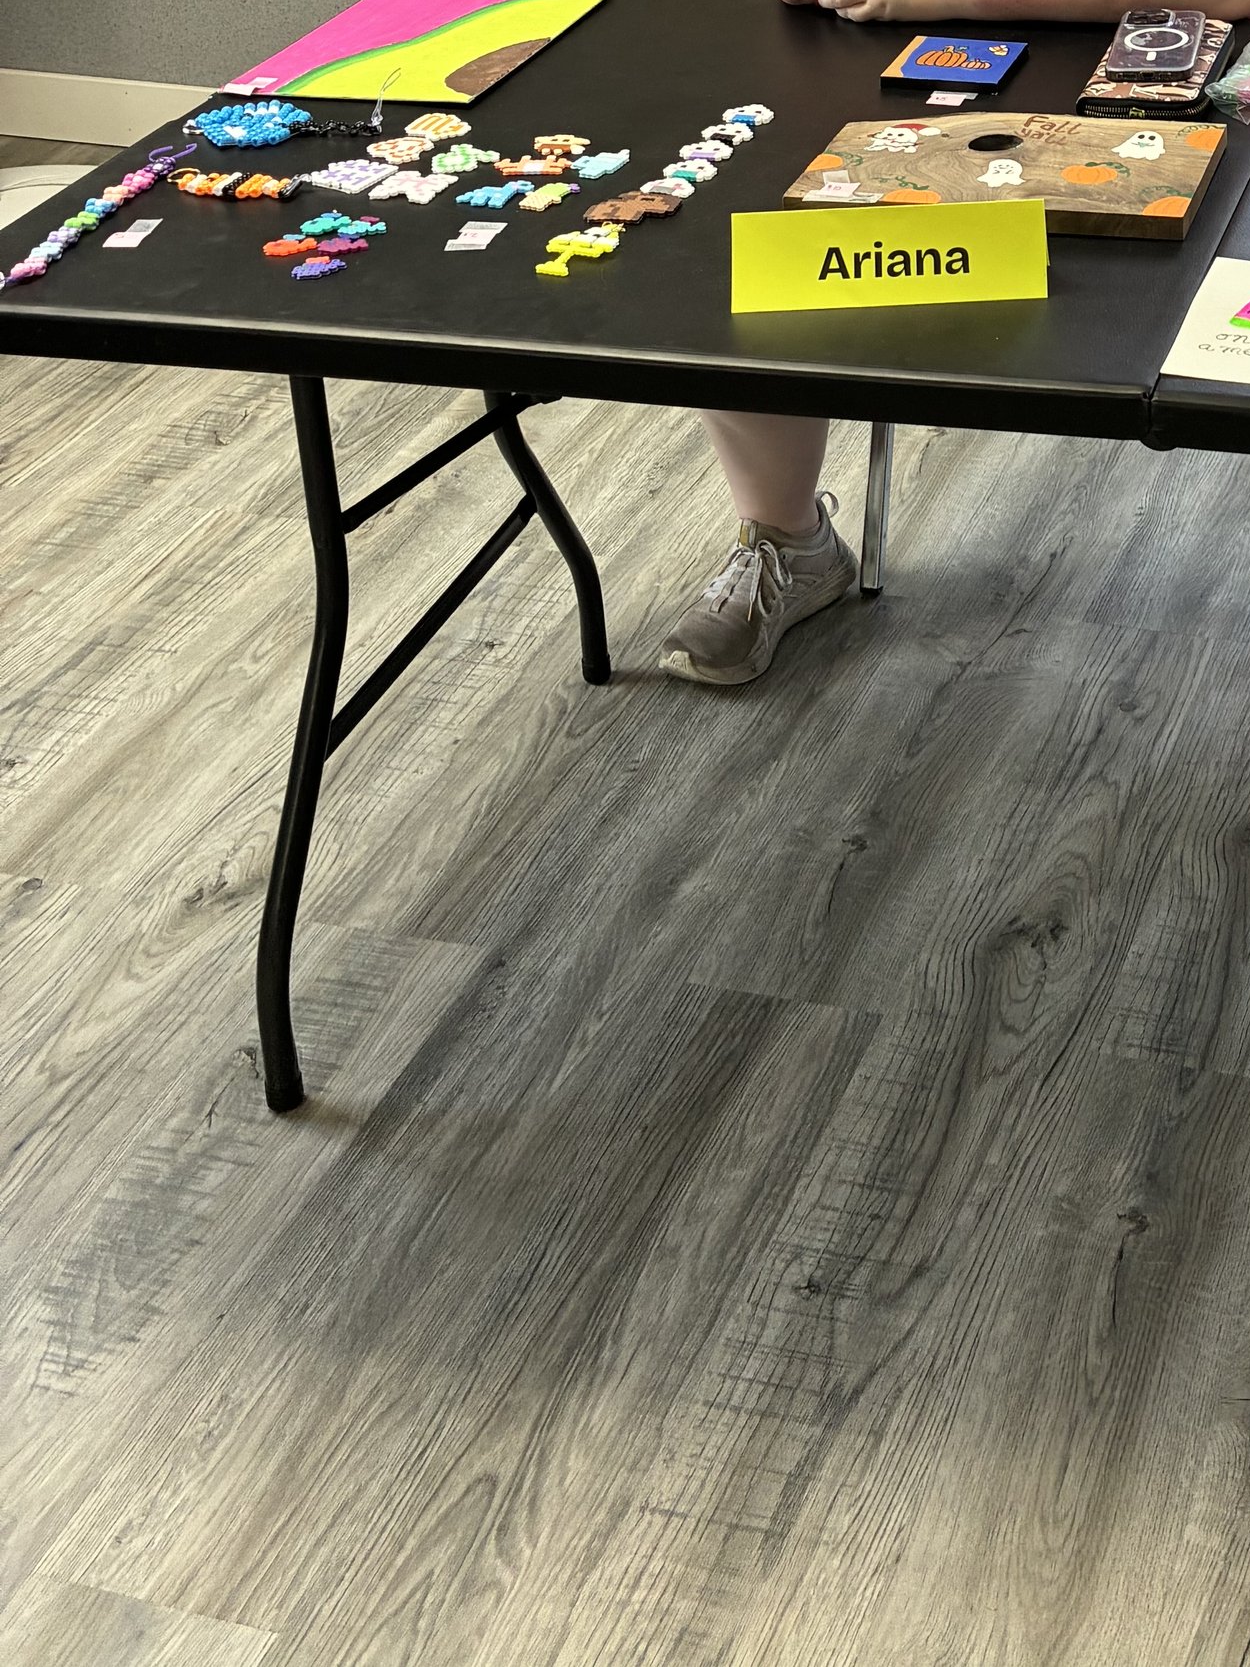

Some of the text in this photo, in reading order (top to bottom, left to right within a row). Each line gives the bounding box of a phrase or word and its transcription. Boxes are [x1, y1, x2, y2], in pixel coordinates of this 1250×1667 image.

[1023, 115, 1082, 135] Fall
[818, 241, 970, 280] Ariana
[1198, 343, 1215, 352] a
